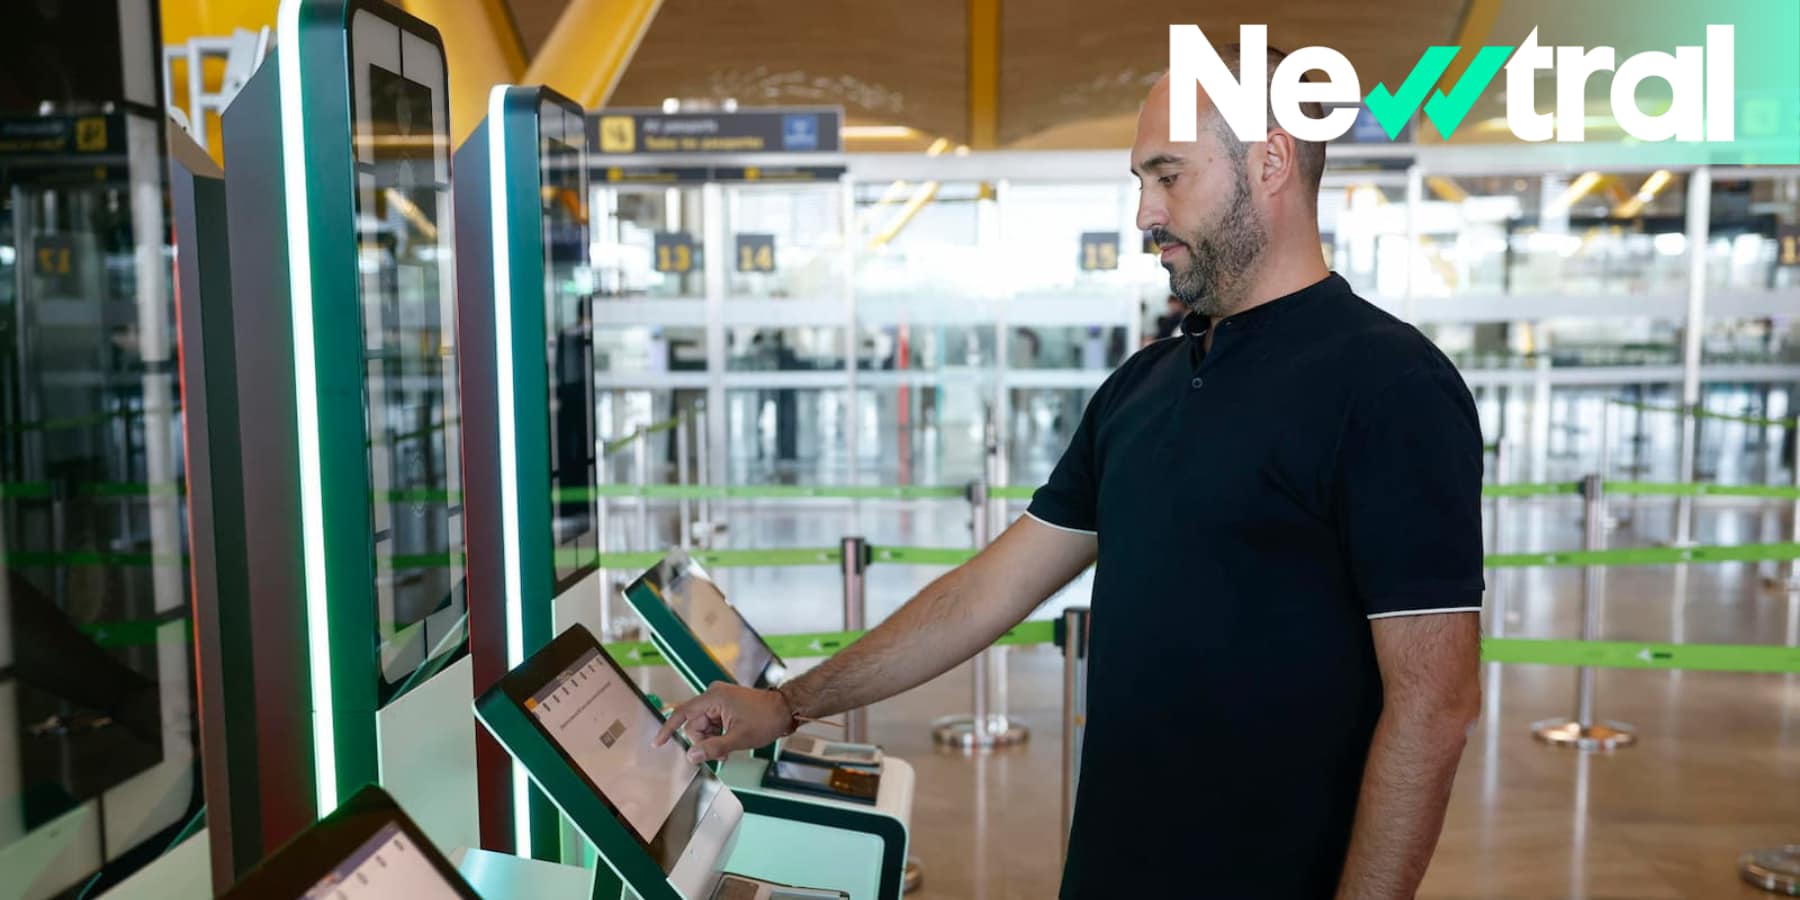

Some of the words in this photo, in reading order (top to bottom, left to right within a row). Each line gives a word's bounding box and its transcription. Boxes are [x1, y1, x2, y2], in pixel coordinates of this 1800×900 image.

[658, 245, 691, 271] 13
[740, 246, 772, 271] 14
[1086, 242, 1116, 268] 15
